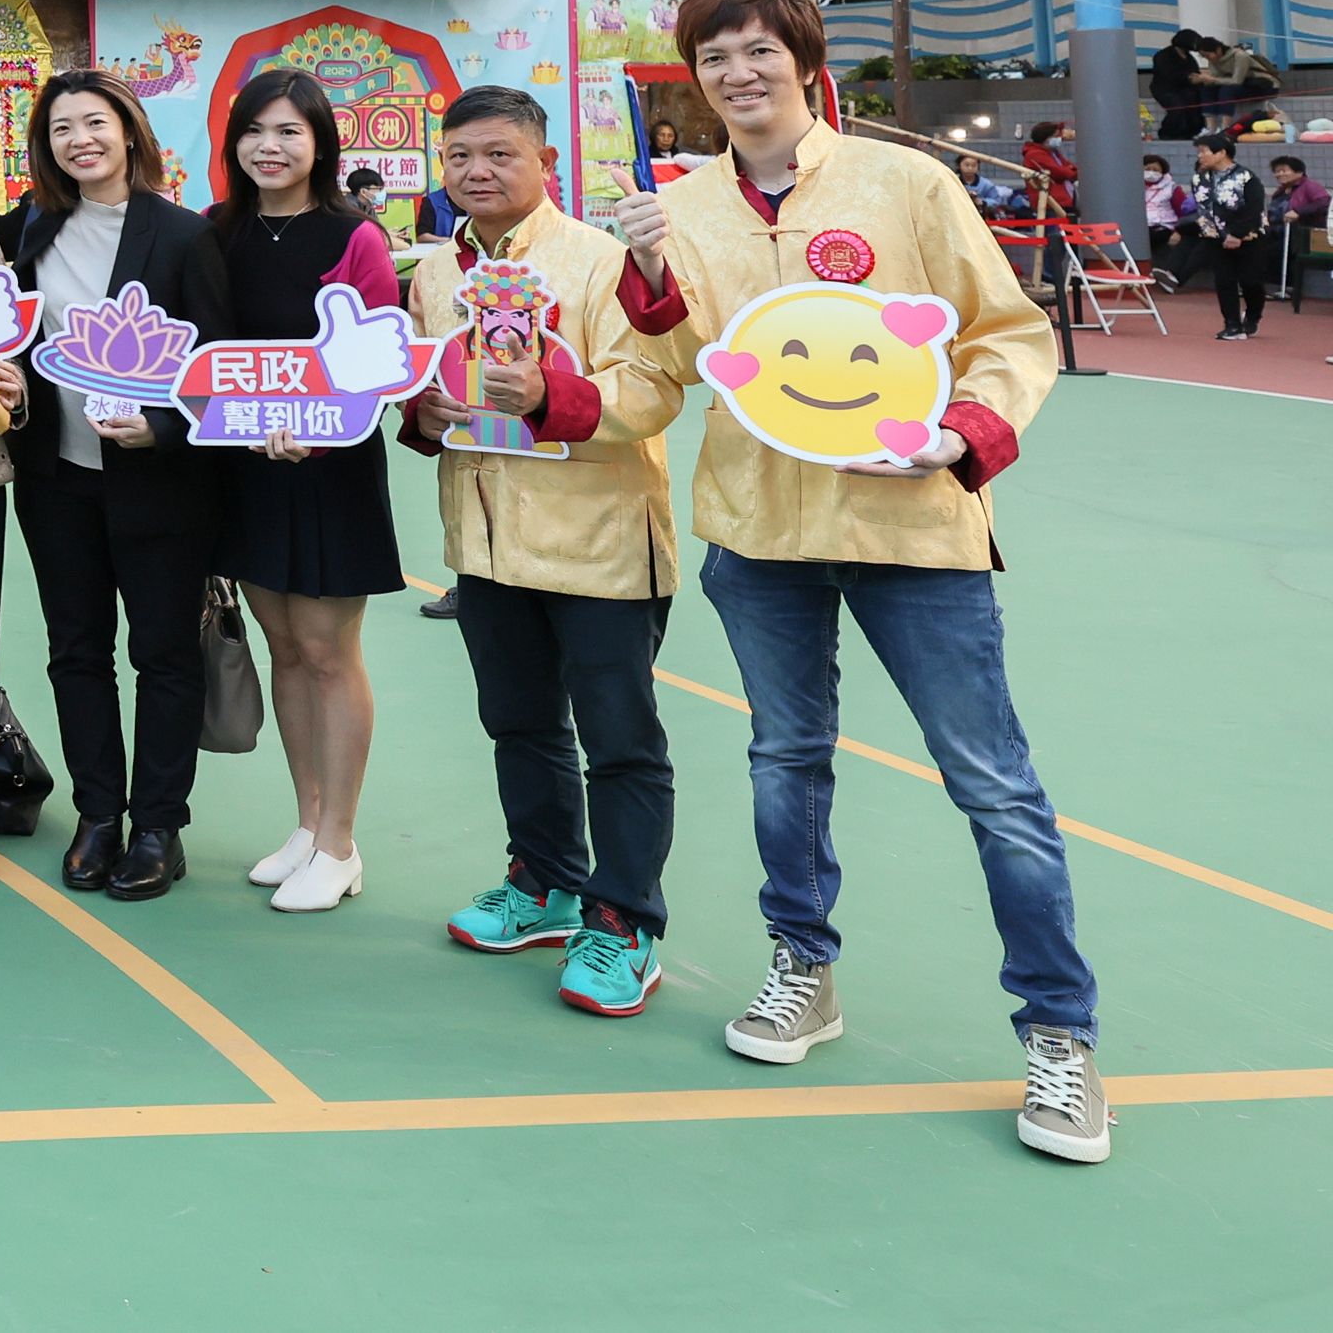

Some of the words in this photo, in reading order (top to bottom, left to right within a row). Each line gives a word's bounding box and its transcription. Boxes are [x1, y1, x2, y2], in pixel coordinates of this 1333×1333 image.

[324, 66, 353, 76] 2024
[210, 351, 309, 394] 民政
[222, 399, 345, 437] 幫到你
